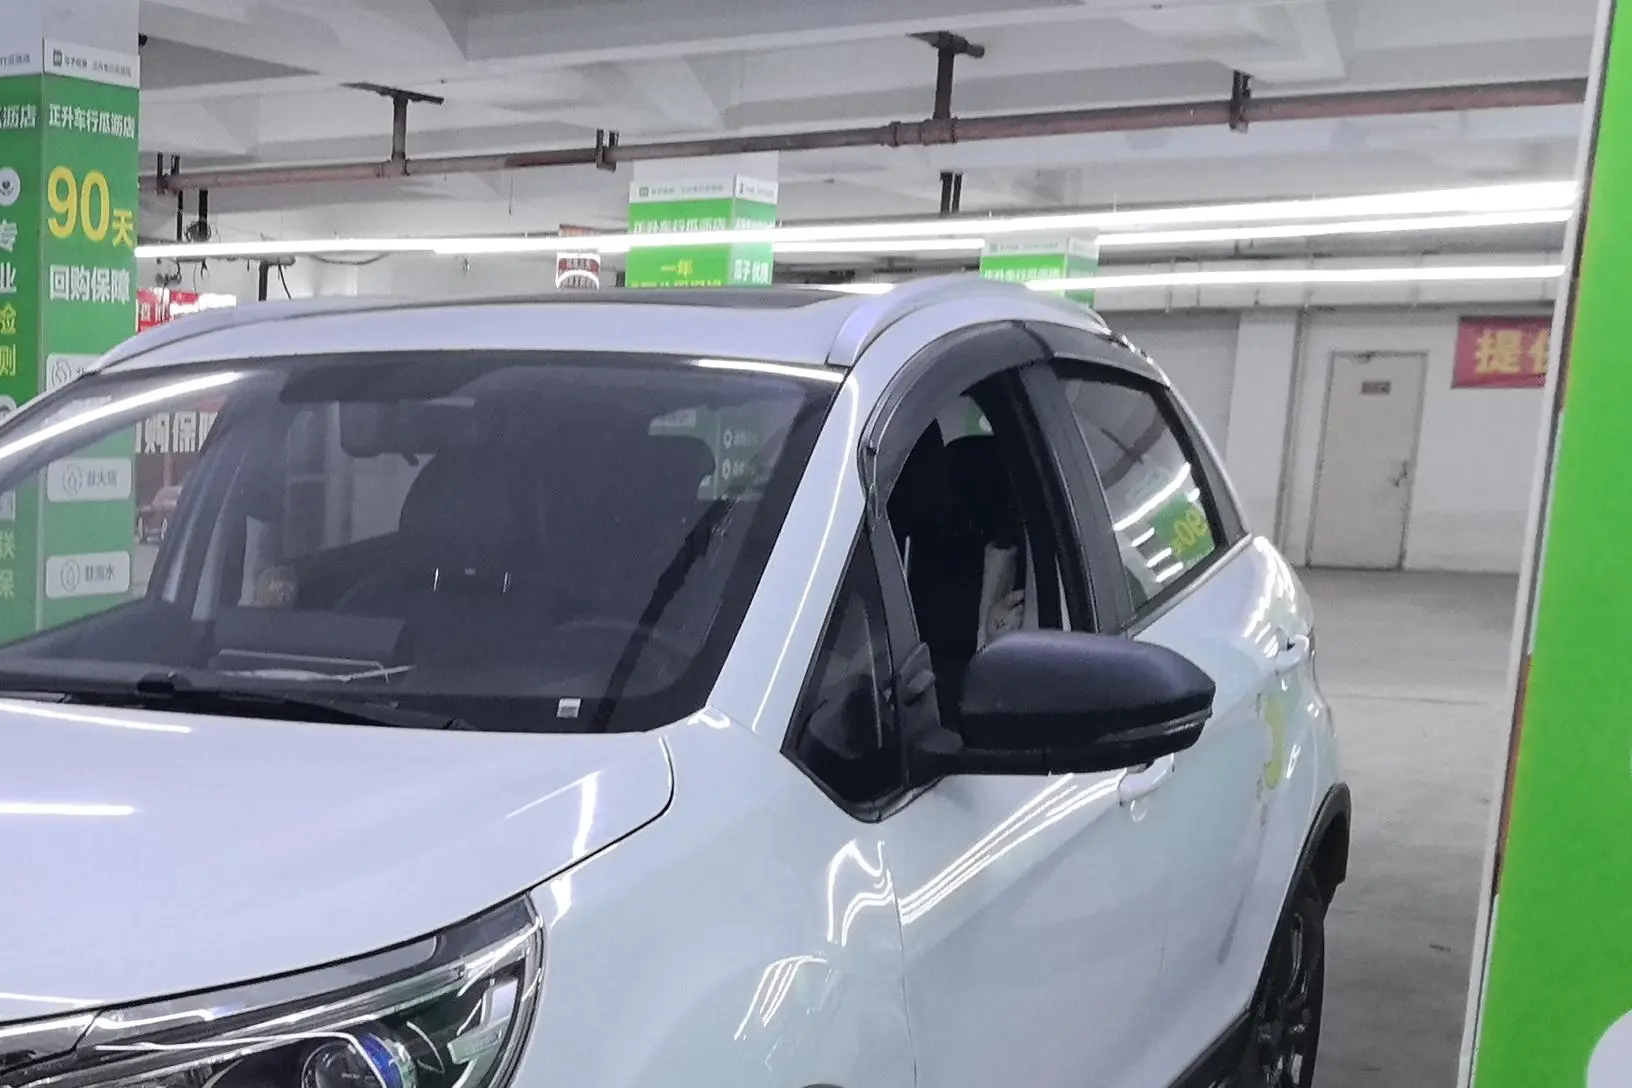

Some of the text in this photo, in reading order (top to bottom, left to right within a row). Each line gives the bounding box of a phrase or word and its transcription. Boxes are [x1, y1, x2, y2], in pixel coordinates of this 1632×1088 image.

[49, 103, 135, 139] 正升车行瓜沥店
[47, 165, 134, 248] 90天
[50, 264, 130, 304] 回购保障
